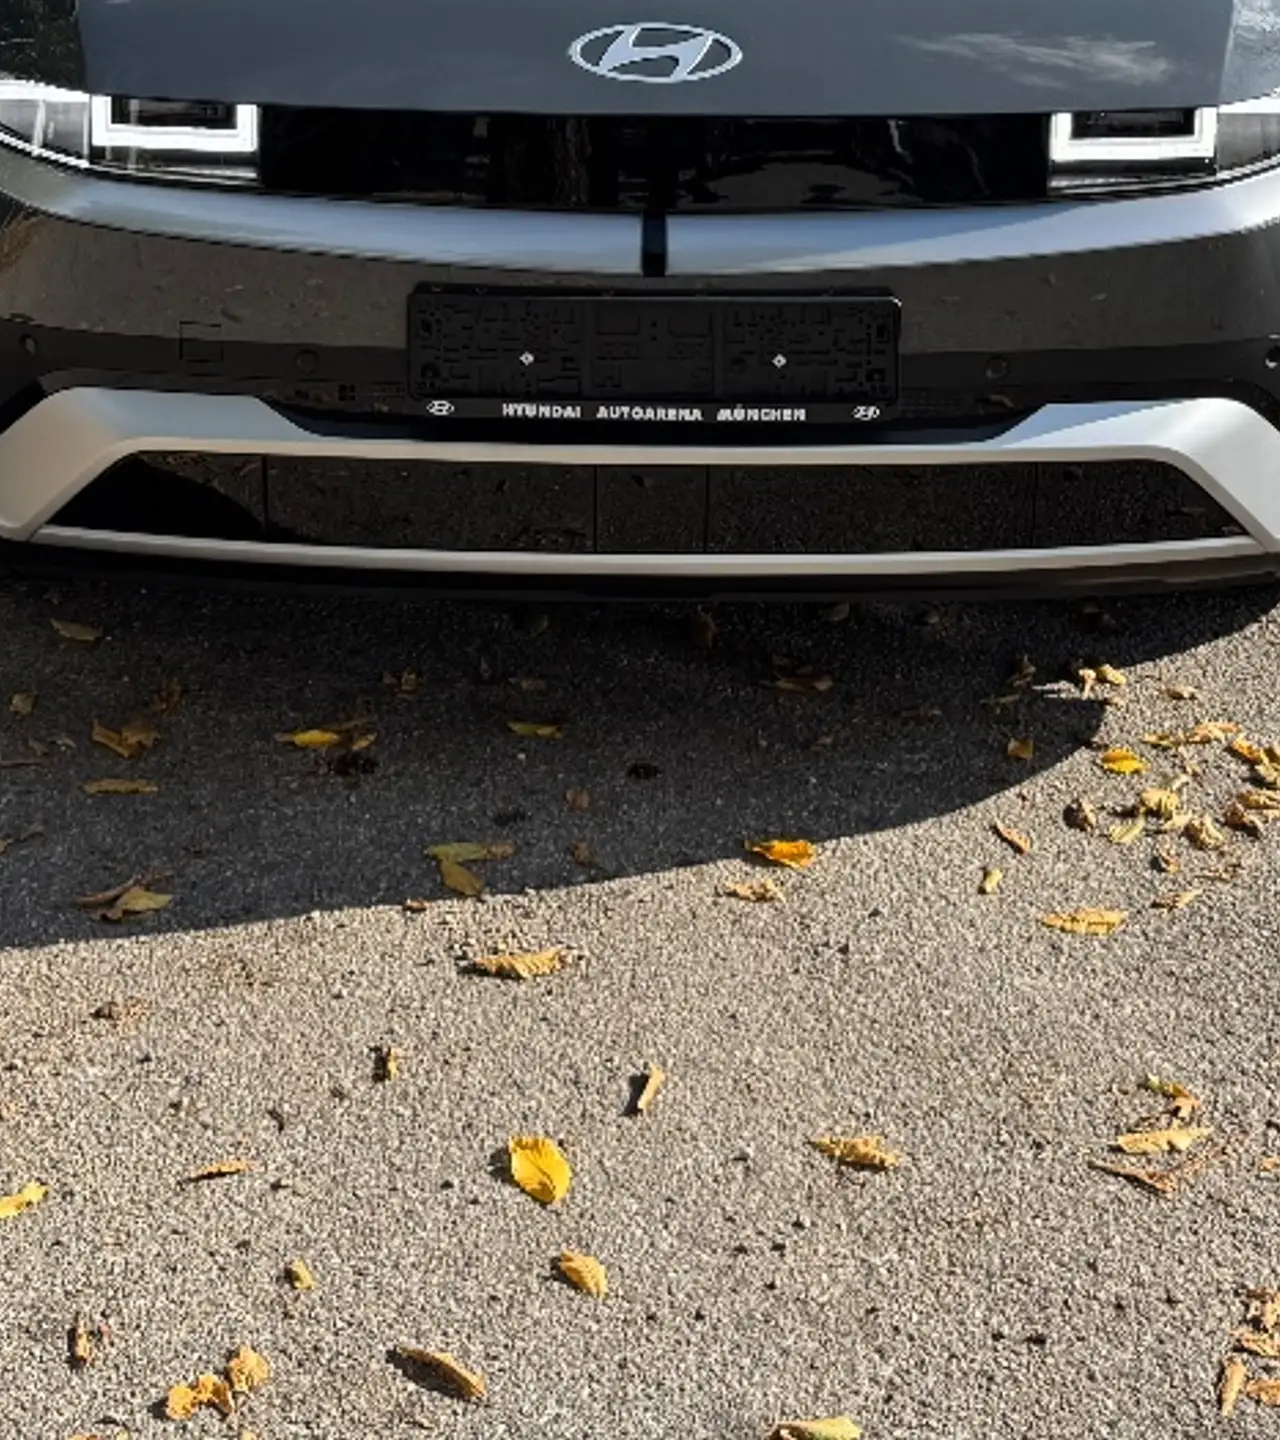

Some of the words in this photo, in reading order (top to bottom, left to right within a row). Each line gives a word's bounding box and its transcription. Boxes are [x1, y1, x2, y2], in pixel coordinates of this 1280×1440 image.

[502, 402, 581, 418] HYUNDAI
[596, 405, 703, 421] AUTOARENA
[717, 403, 806, 421] MÜNCHEN
